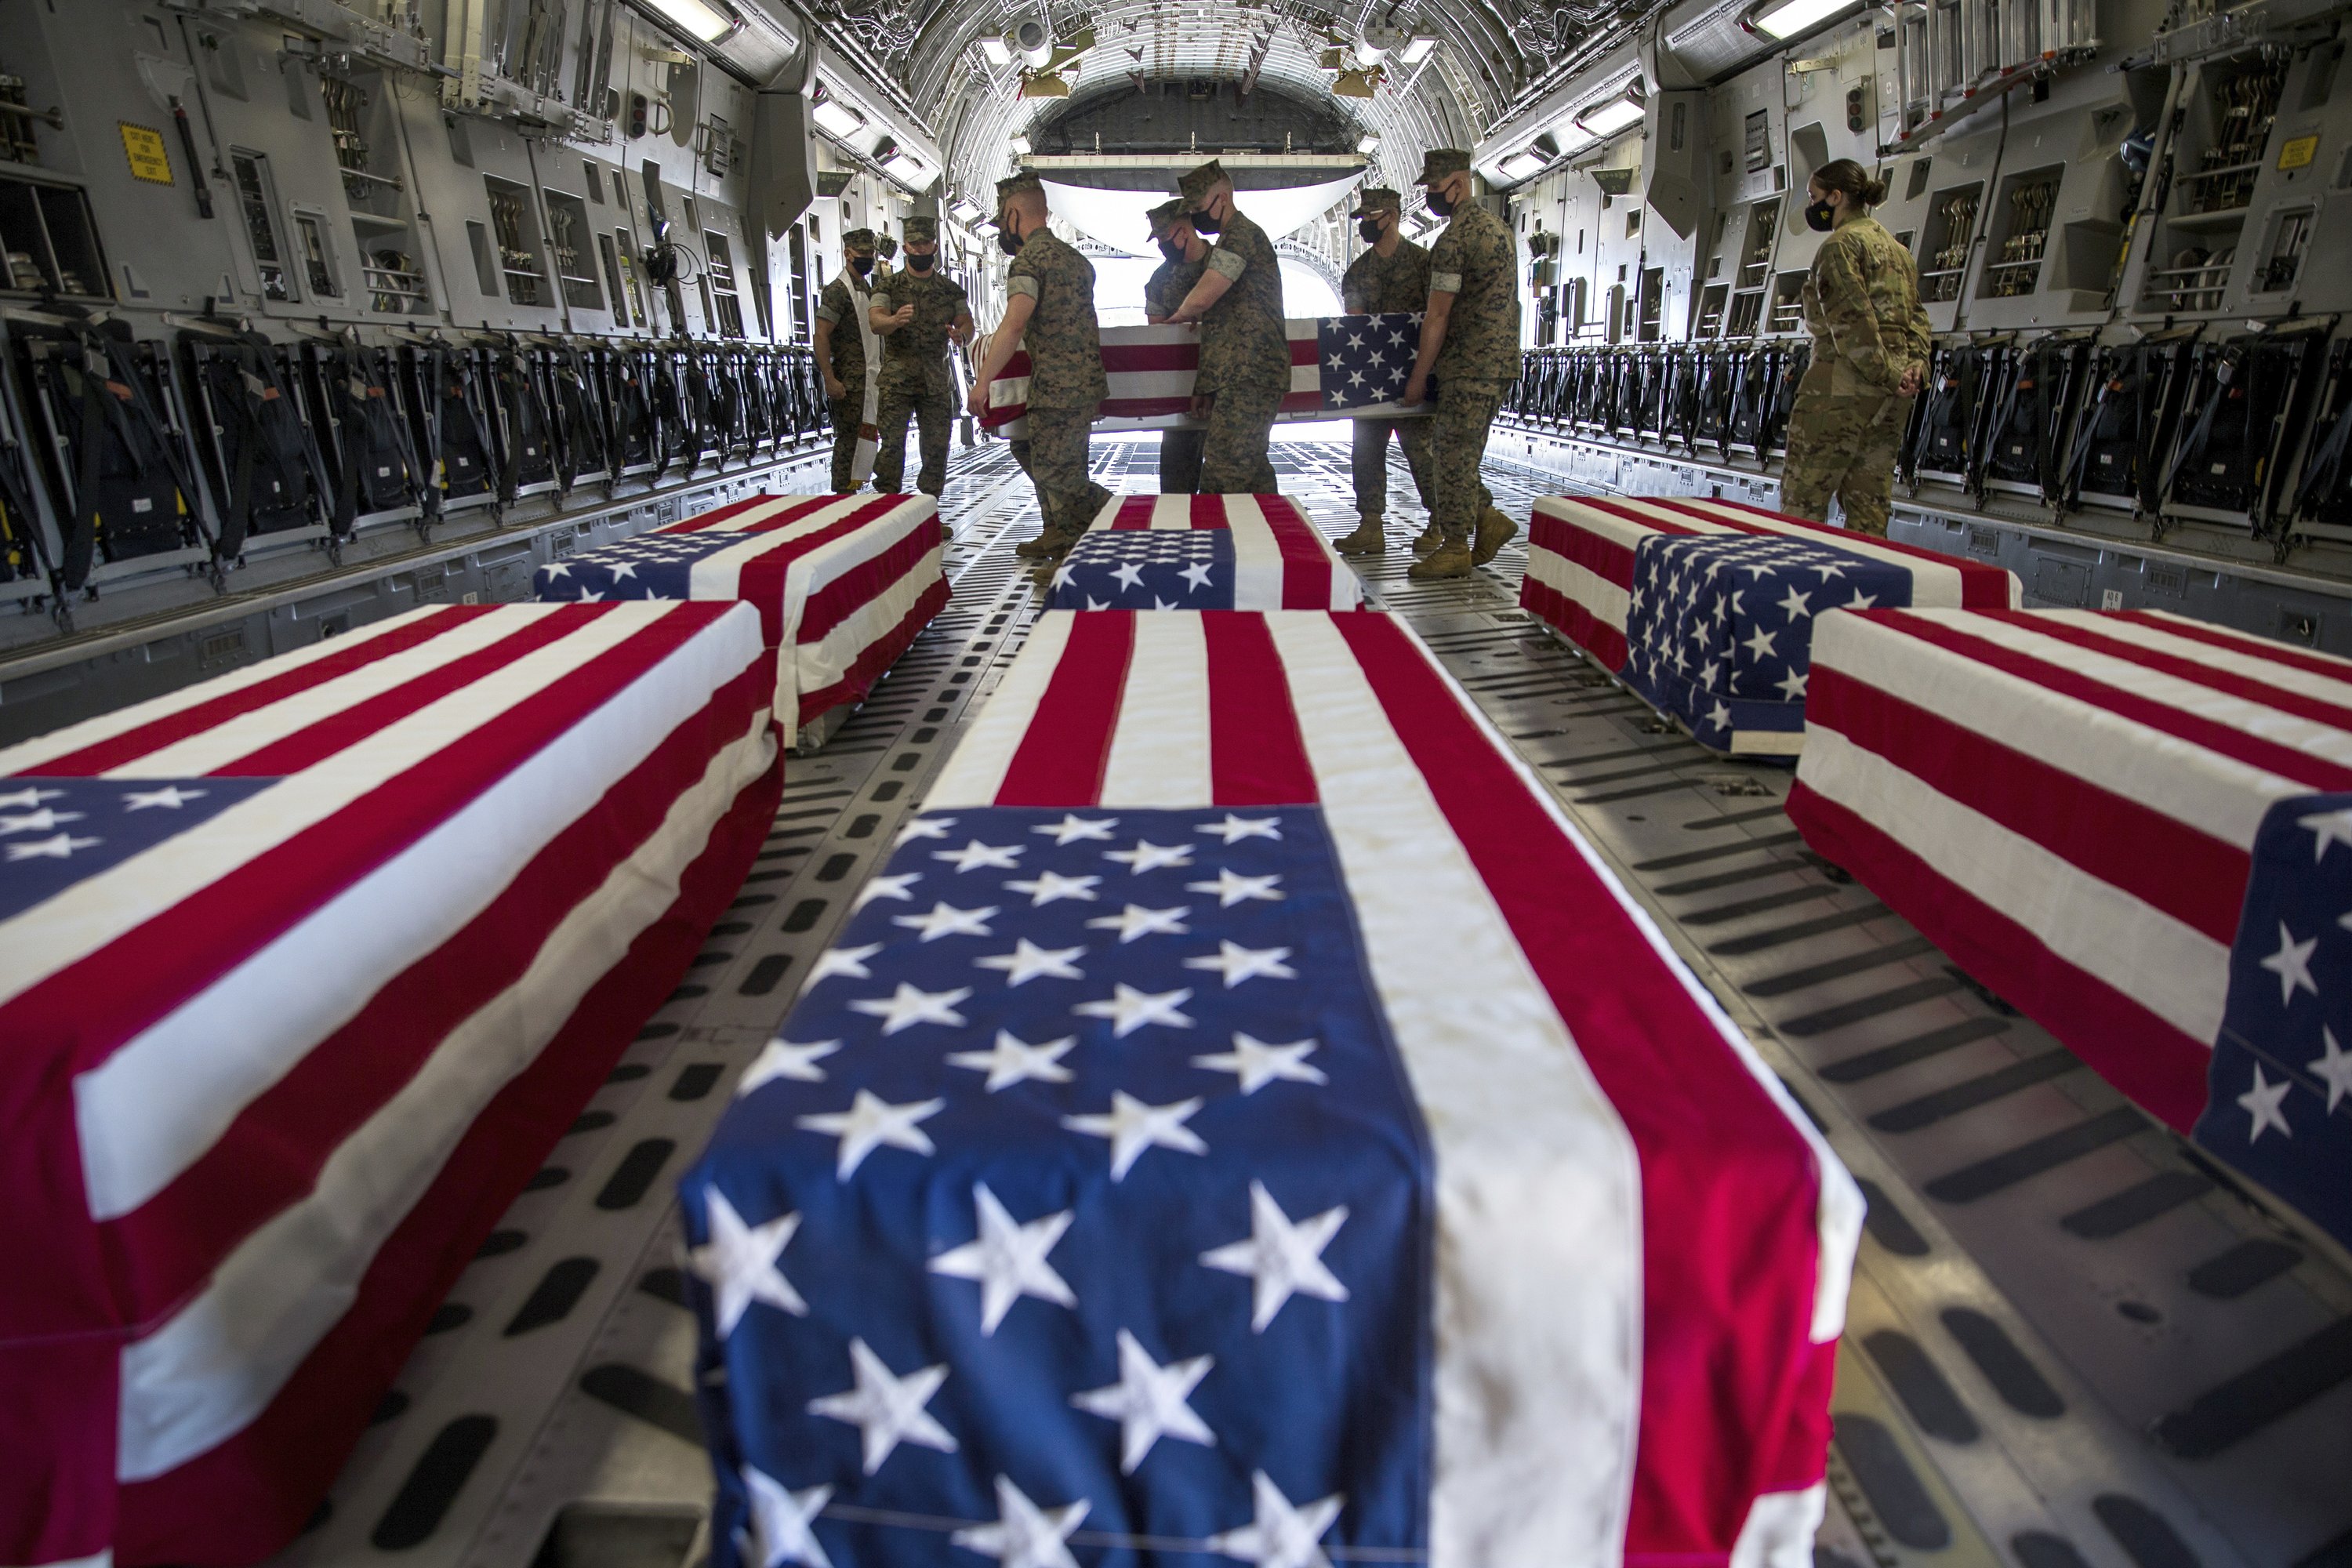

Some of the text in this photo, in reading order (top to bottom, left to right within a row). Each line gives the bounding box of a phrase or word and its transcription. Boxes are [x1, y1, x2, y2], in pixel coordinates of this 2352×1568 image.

[133, 152, 163, 166] EMERGENCY
[145, 165, 158, 176] EXIT
[2114, 593, 2118, 602] 6
